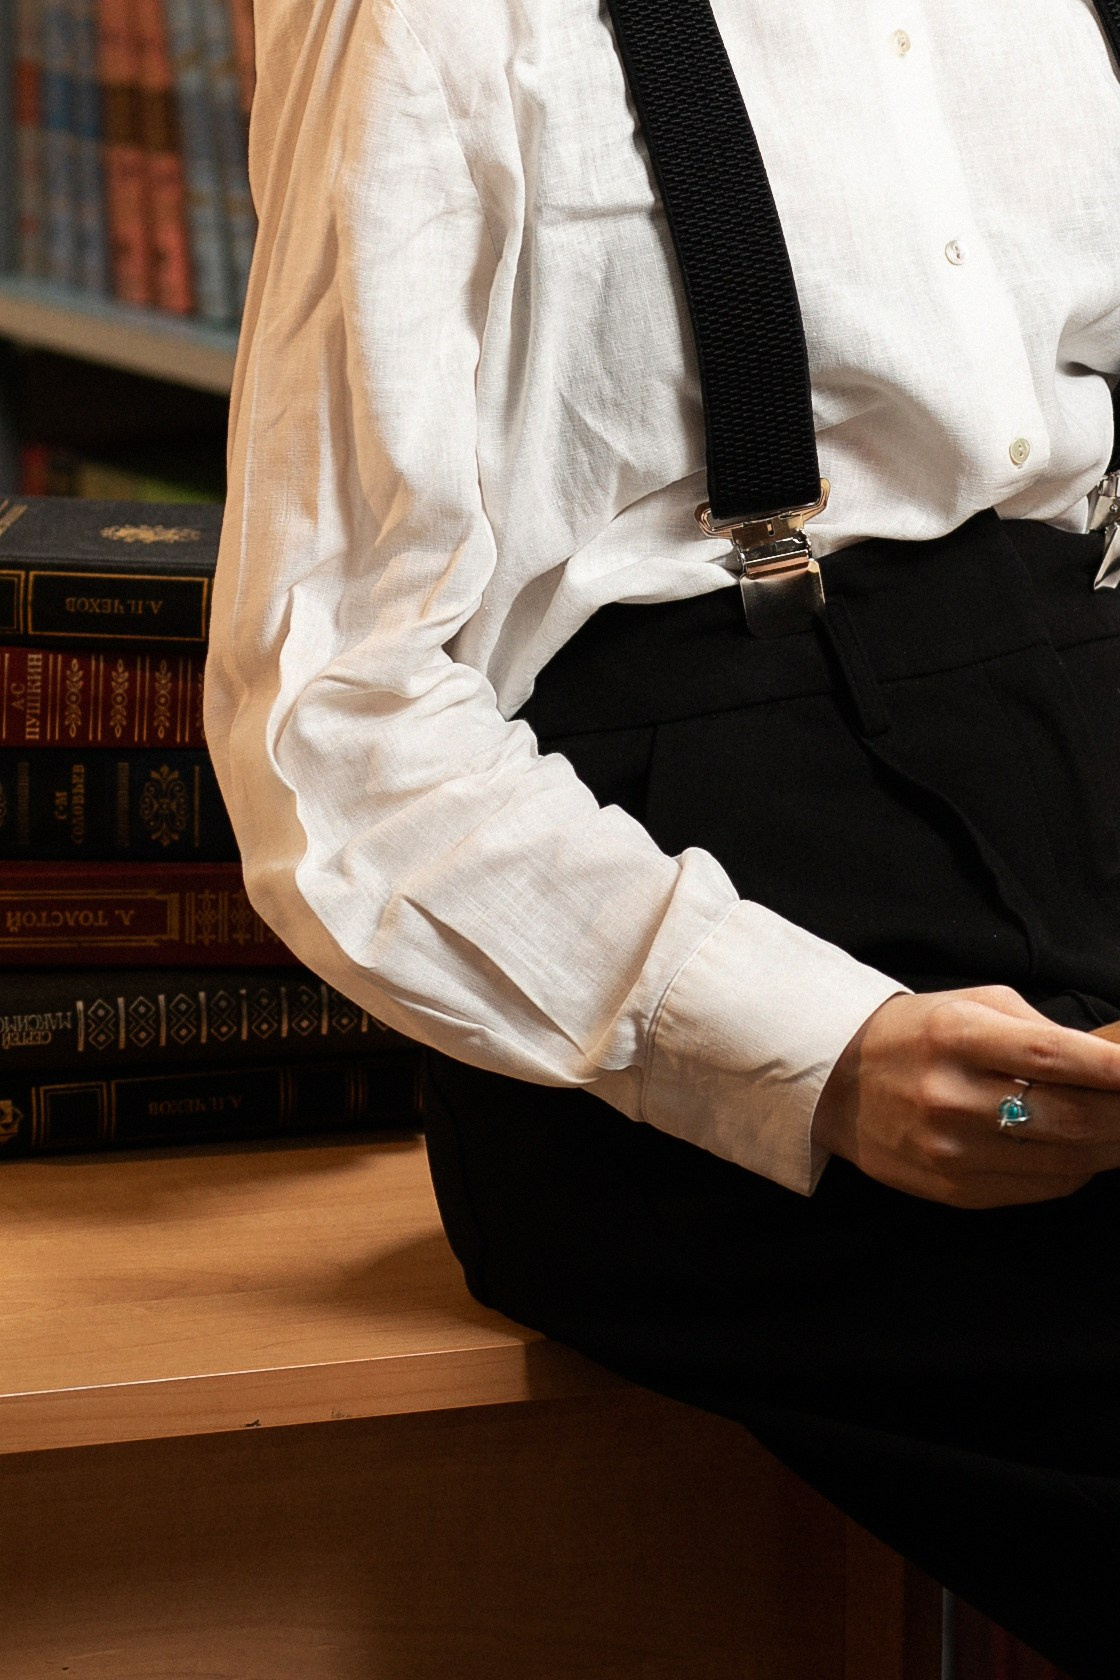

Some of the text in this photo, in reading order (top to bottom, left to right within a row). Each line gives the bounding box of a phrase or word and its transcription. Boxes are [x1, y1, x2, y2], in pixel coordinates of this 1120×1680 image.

[25, 653, 42, 741] ПУШКИН
[5, 910, 109, 932] ТОЛСТОЙ
[1, 1030, 52, 1050] СЕРГЕЙ
